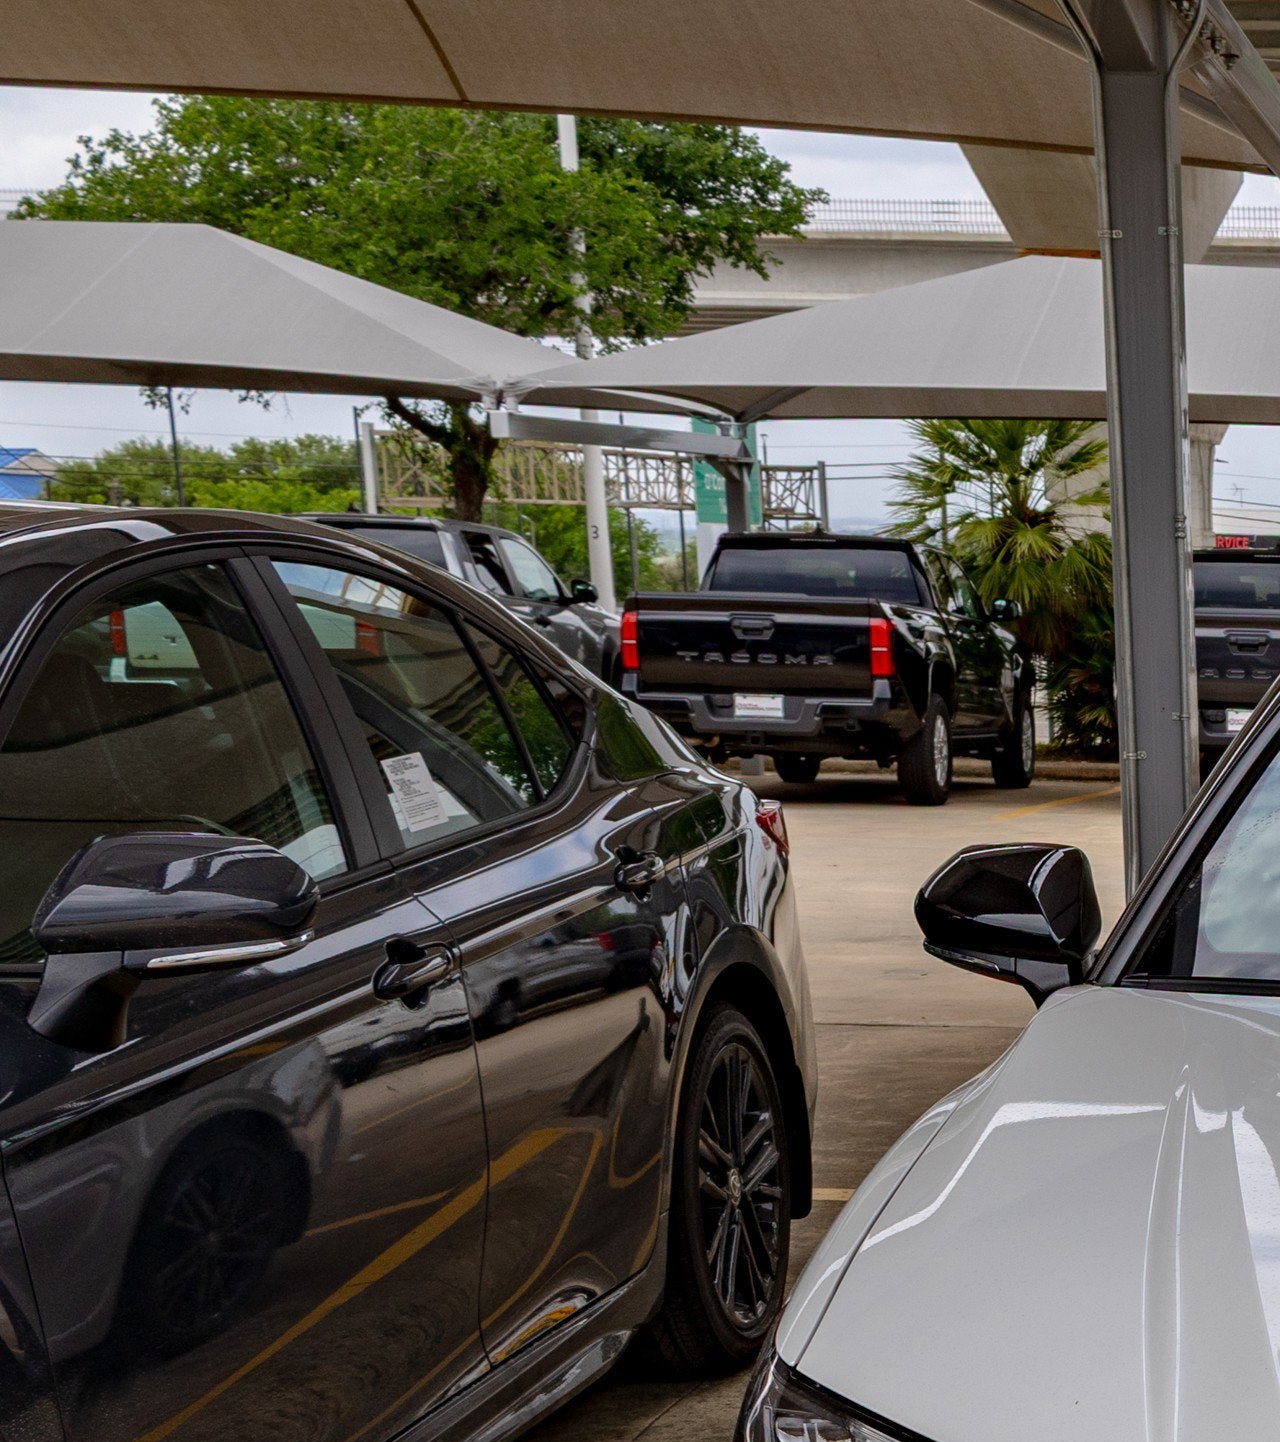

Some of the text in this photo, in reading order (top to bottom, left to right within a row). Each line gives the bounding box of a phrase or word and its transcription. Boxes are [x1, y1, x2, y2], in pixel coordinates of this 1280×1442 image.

[591, 525, 600, 539] 3
[1216, 536, 1249, 548] RVICE
[676, 651, 834, 665] TACOMA
